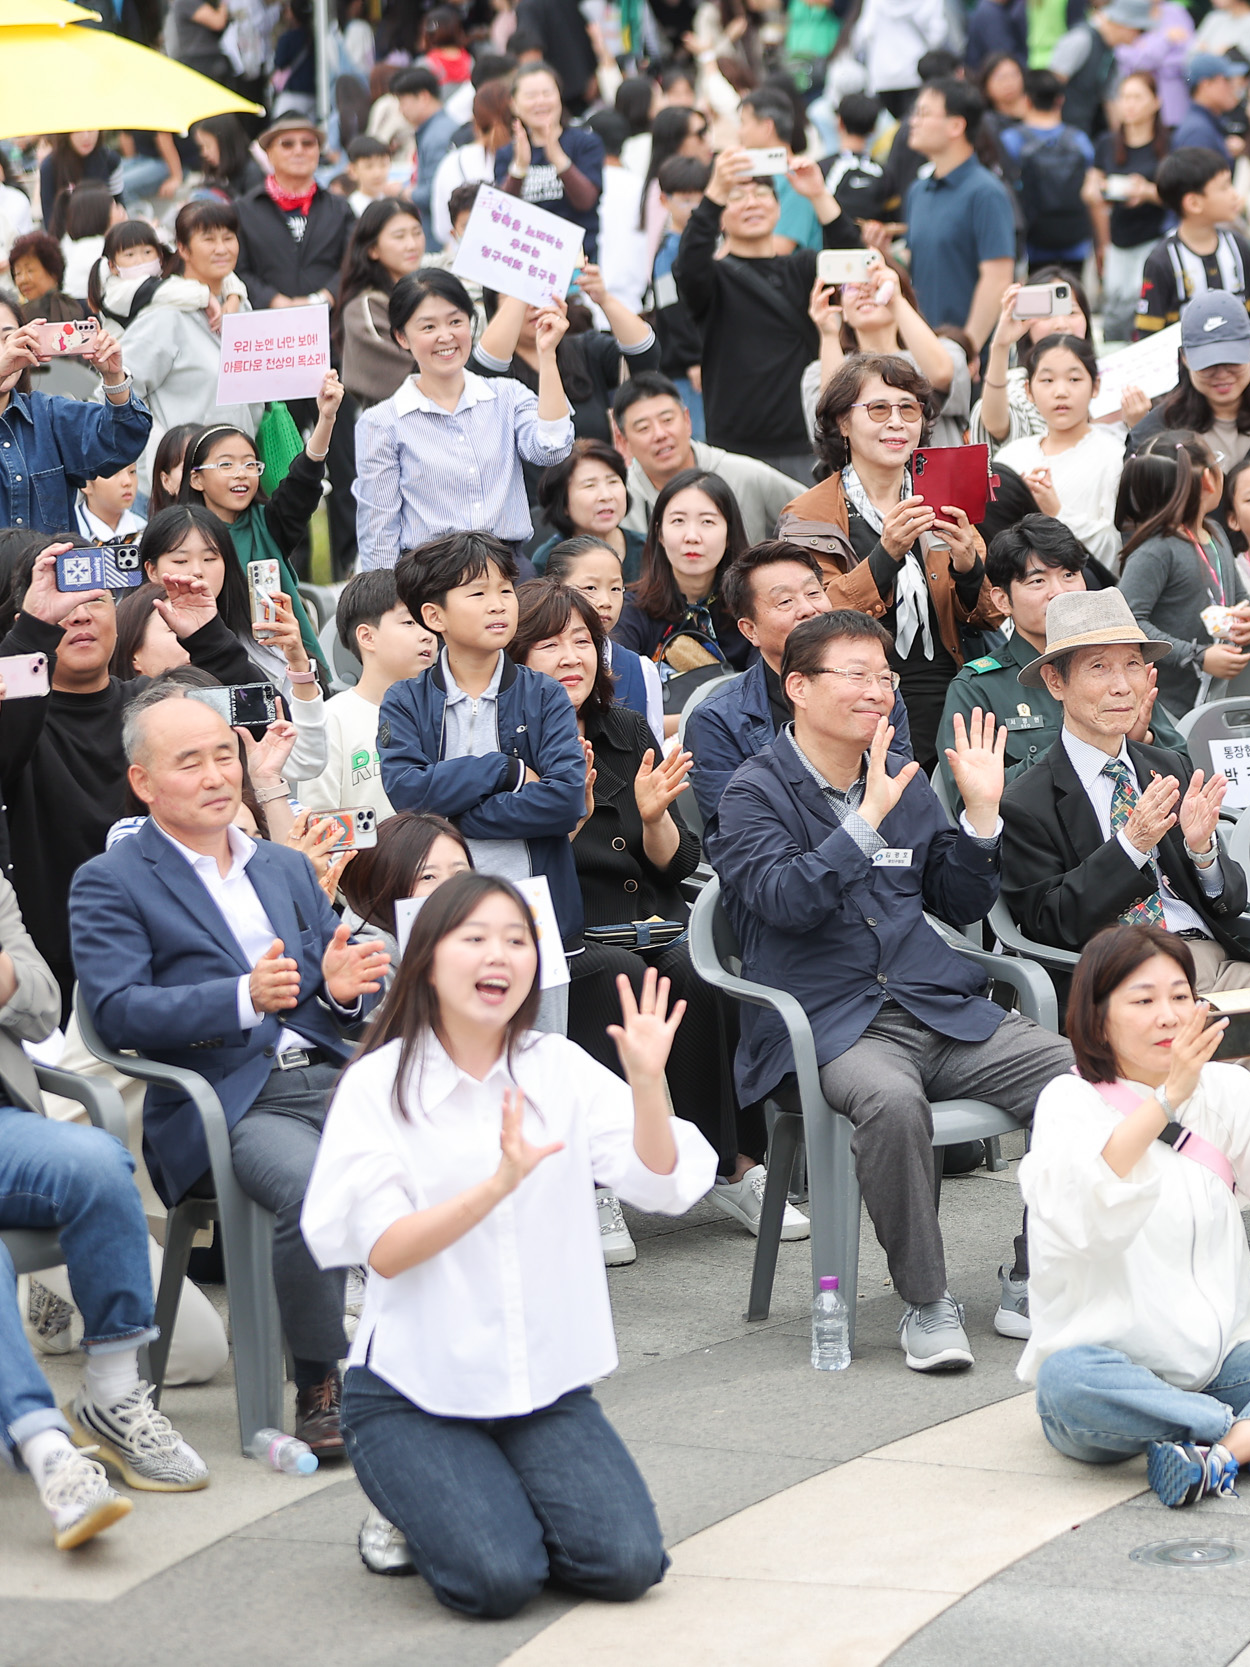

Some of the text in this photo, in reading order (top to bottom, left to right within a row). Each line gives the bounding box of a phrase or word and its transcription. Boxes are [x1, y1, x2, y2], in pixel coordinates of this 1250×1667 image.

[233, 332, 319, 354] 우리 눈엔 너만 보여!
[223, 352, 327, 374] 아름다운 천상의 목소리!
[94, 556, 102, 582] Supreme
